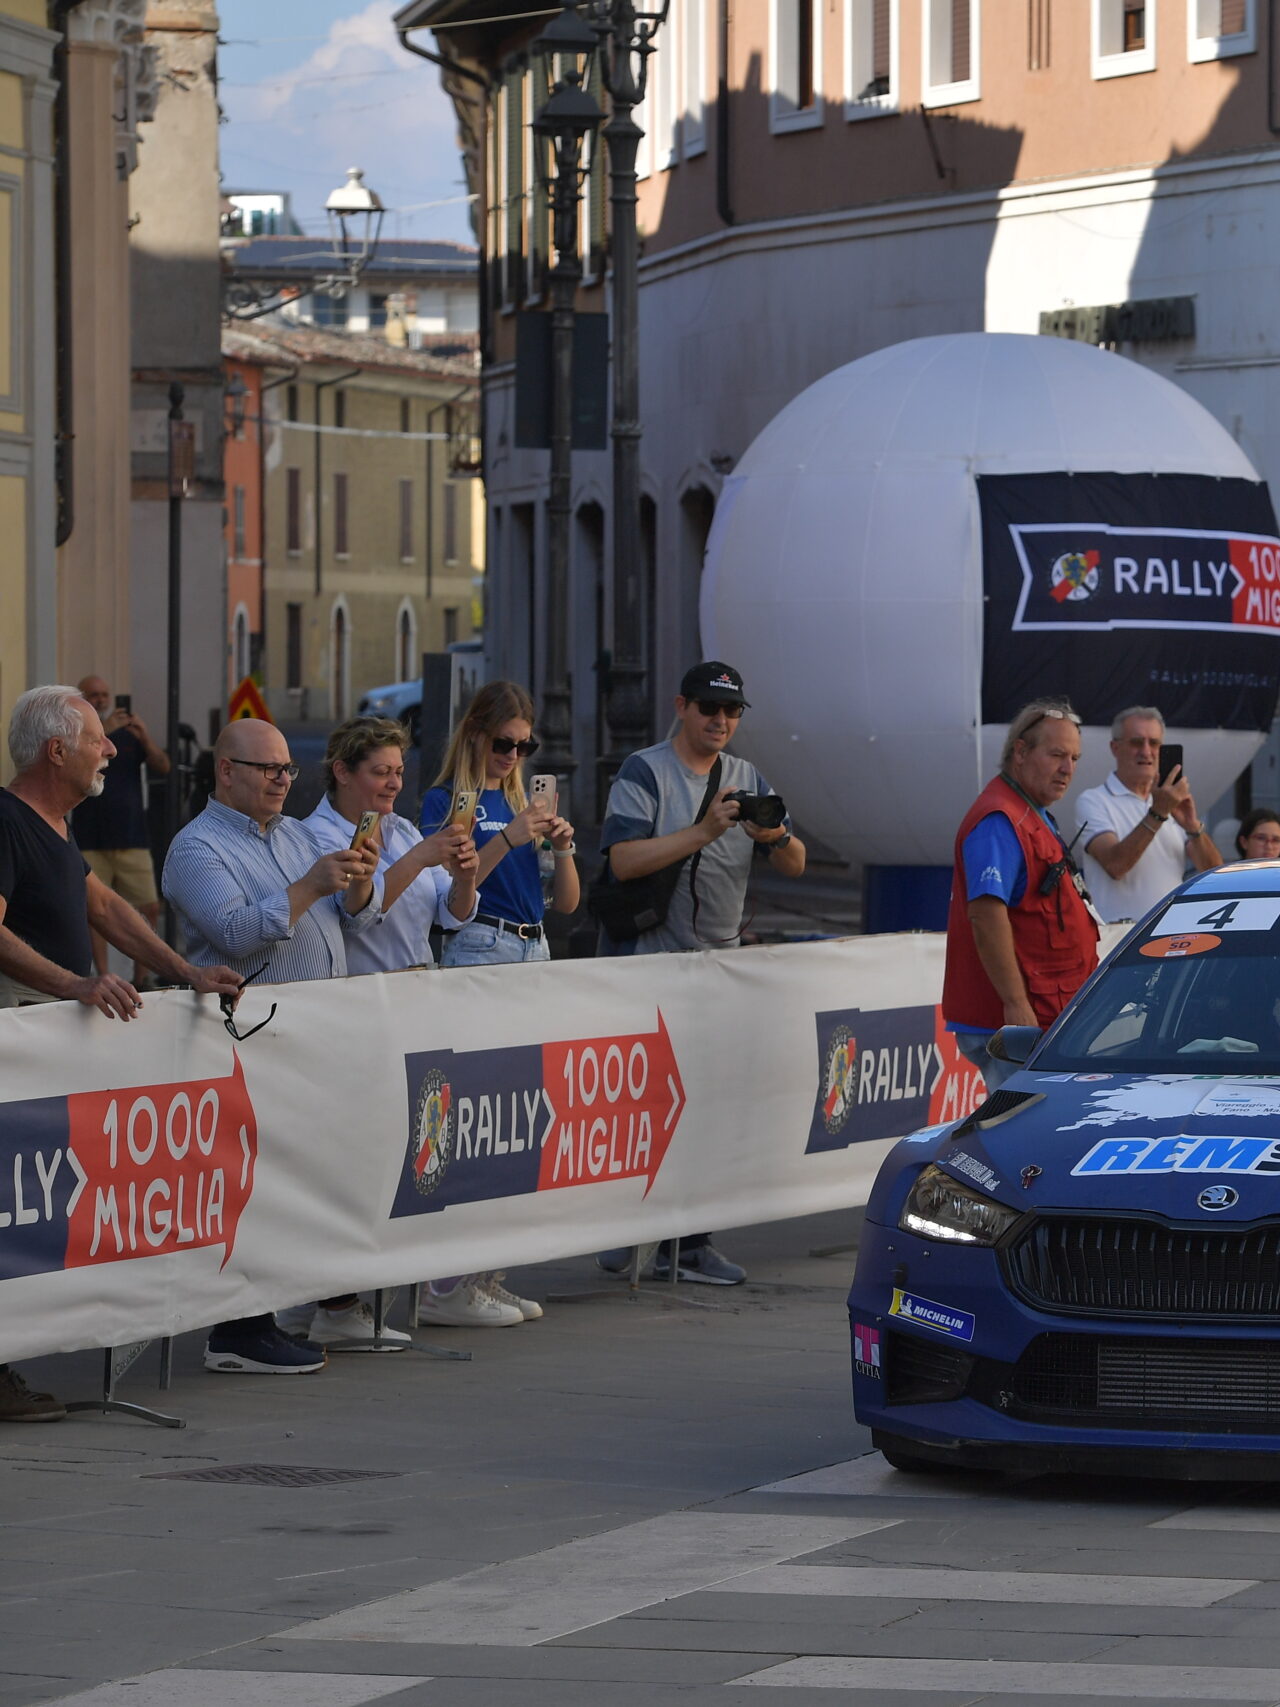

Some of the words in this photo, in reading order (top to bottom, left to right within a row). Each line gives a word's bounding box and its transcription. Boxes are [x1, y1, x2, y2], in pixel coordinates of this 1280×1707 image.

[1113, 556, 1228, 597] RALLY
[1196, 900, 1241, 930] 4
[1168, 941, 1192, 950] SD
[563, 1041, 649, 1109] 1000
[858, 1043, 932, 1105] RALLY
[939, 1070, 987, 1123] MIG
[102, 1087, 220, 1169] 1000
[456, 1088, 541, 1161] RALLY
[552, 1111, 652, 1183] MIGLIA
[1078, 1136, 1275, 1173] REM
[89, 1167, 225, 1257] MIGLIA
[913, 1305, 965, 1330] MICHELIN
[855, 1360, 881, 1380] CITIA
